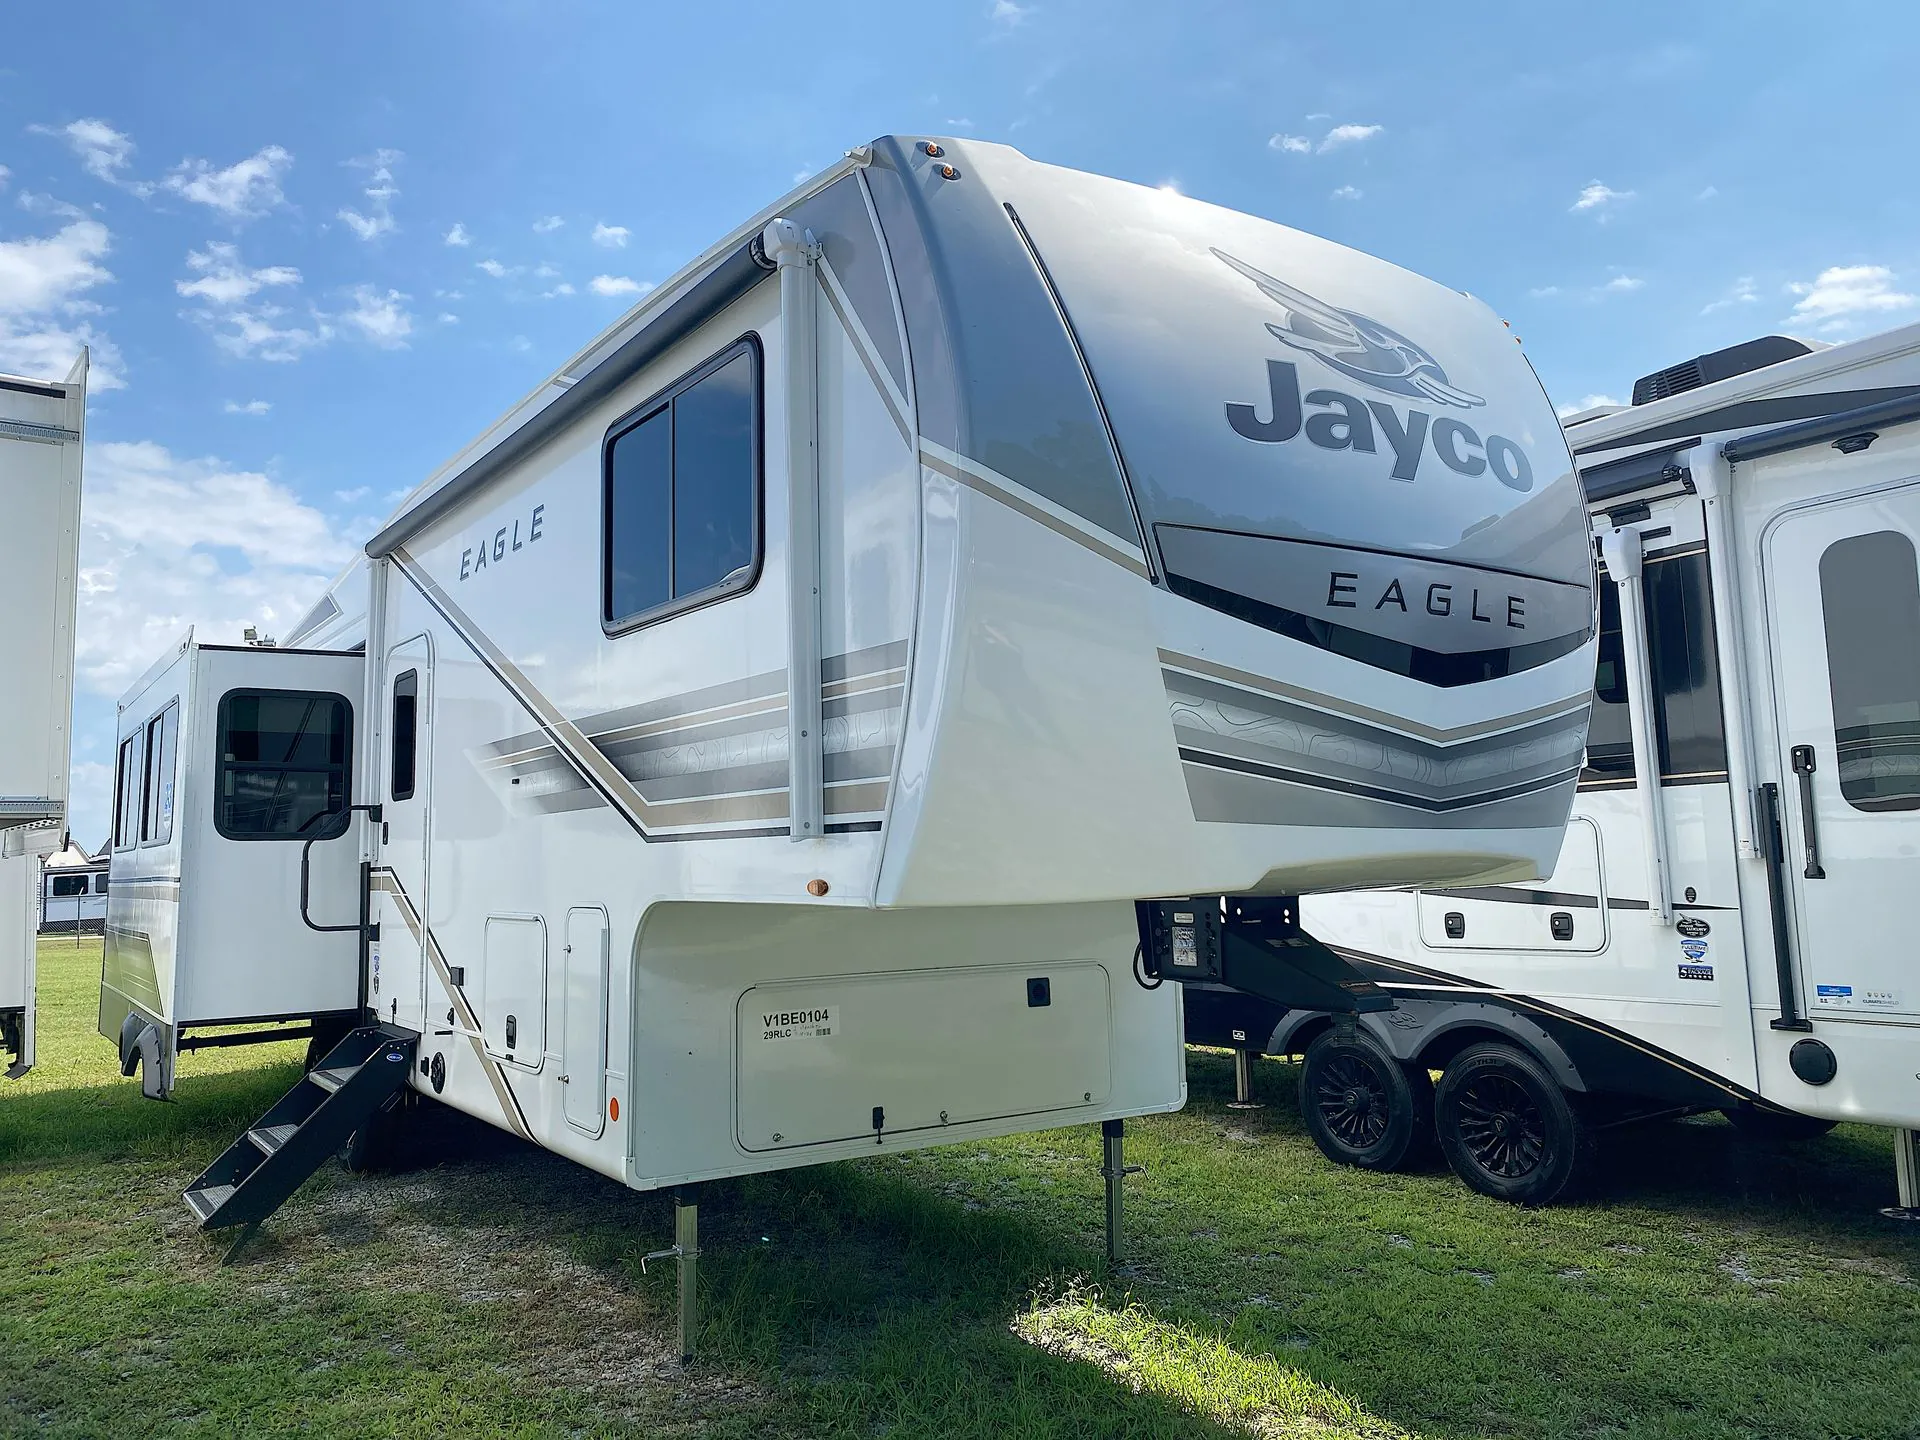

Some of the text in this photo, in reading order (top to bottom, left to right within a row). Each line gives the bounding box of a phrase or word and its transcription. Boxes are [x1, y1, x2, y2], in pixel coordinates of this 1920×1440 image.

[1224, 359, 1534, 493] Jayco
[459, 504, 544, 581] EAGLE
[1326, 571, 1526, 629] EAGLE
[763, 1009, 829, 1027] V1BE0104
[763, 1029, 792, 1040] 29RLC
